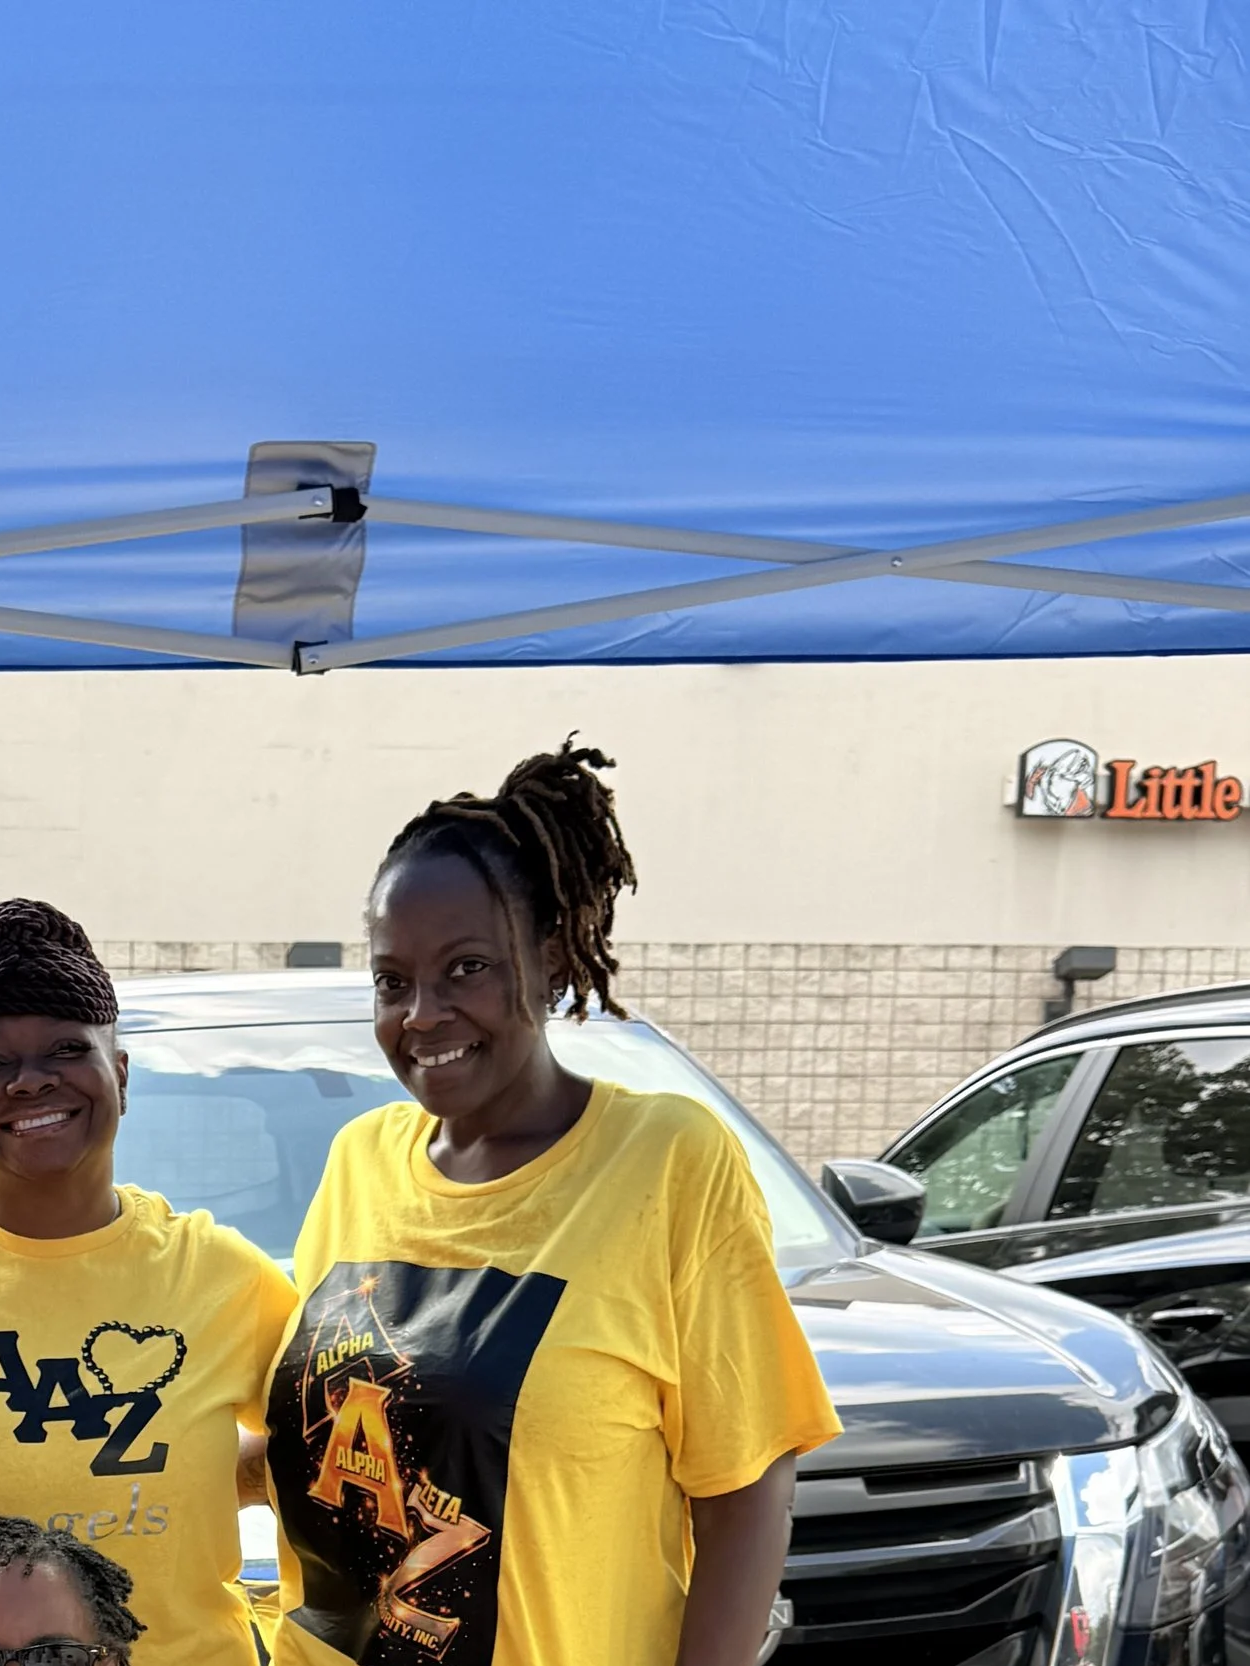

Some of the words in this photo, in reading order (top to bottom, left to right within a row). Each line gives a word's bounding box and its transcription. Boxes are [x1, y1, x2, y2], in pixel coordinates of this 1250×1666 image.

[1101, 760, 1243, 820] Little
[316, 1331, 375, 1377] ALPHA
[335, 1448, 387, 1484] ALPHA
[418, 1481, 462, 1525] ZETA
